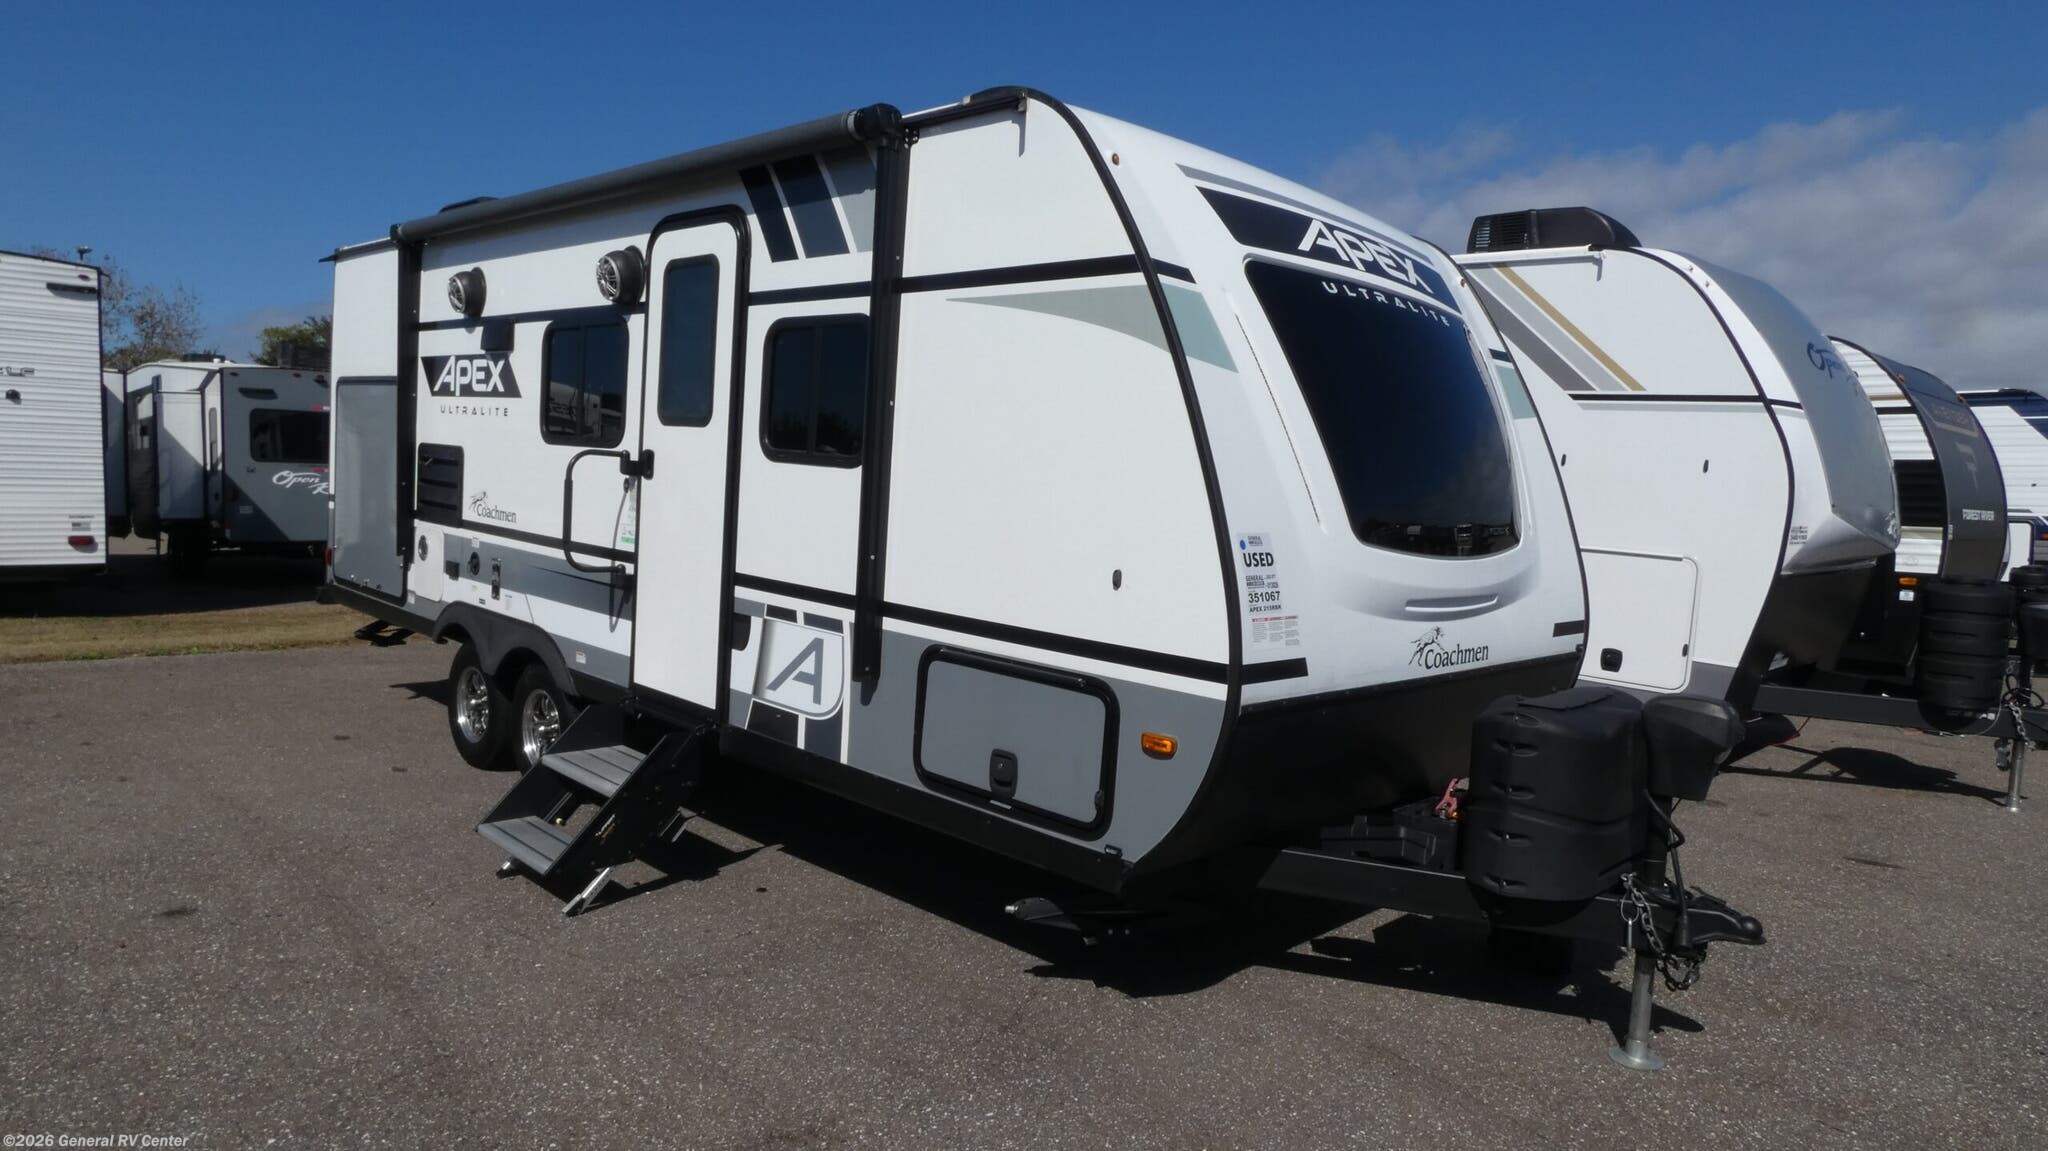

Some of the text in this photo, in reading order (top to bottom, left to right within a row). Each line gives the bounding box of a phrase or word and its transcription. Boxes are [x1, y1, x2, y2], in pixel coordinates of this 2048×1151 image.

[1298, 218, 1435, 294] APEX
[1321, 280, 1450, 327] ULTRALITE
[433, 355, 505, 397] APEX
[440, 405, 509, 417] ULTRALITE
[272, 470, 321, 488] Open
[476, 503, 517, 523] Coachmen
[1243, 552, 1274, 568] USED
[1248, 590, 1281, 604] 351067
[1424, 643, 1489, 670] Coachmen
[766, 637, 824, 705] A
